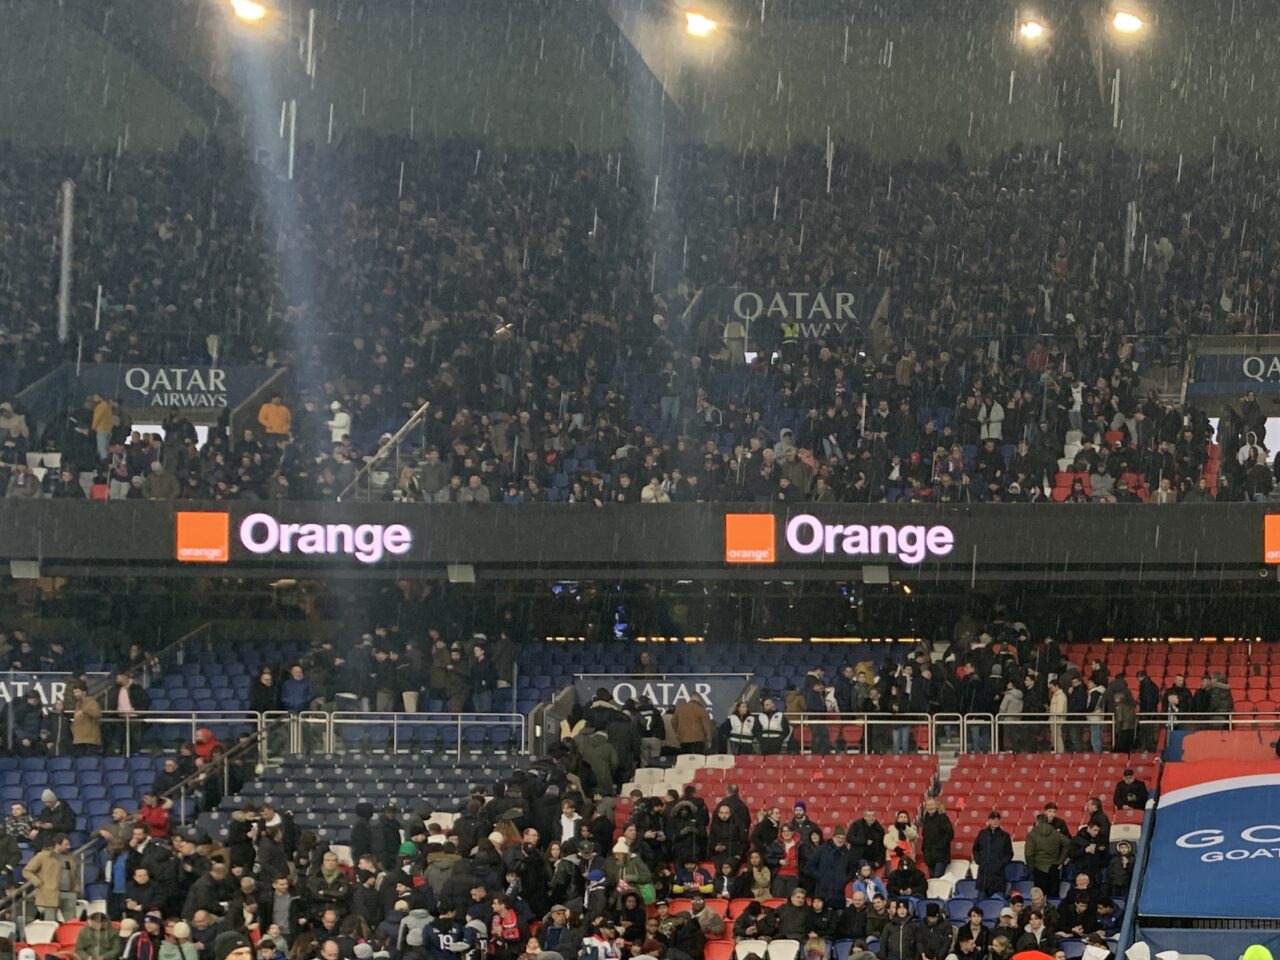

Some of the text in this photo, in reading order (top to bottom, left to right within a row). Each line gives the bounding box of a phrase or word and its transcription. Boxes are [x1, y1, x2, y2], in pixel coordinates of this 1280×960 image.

[734, 291, 857, 321] QATAR
[125, 367, 227, 396] QATAR
[151, 392, 228, 407] AIRWAYS
[240, 512, 412, 563] Orange
[786, 514, 955, 564] Orange
[728, 549, 769, 561] orange
[613, 682, 713, 705] QATAR
[438, 934, 453, 950] 19
